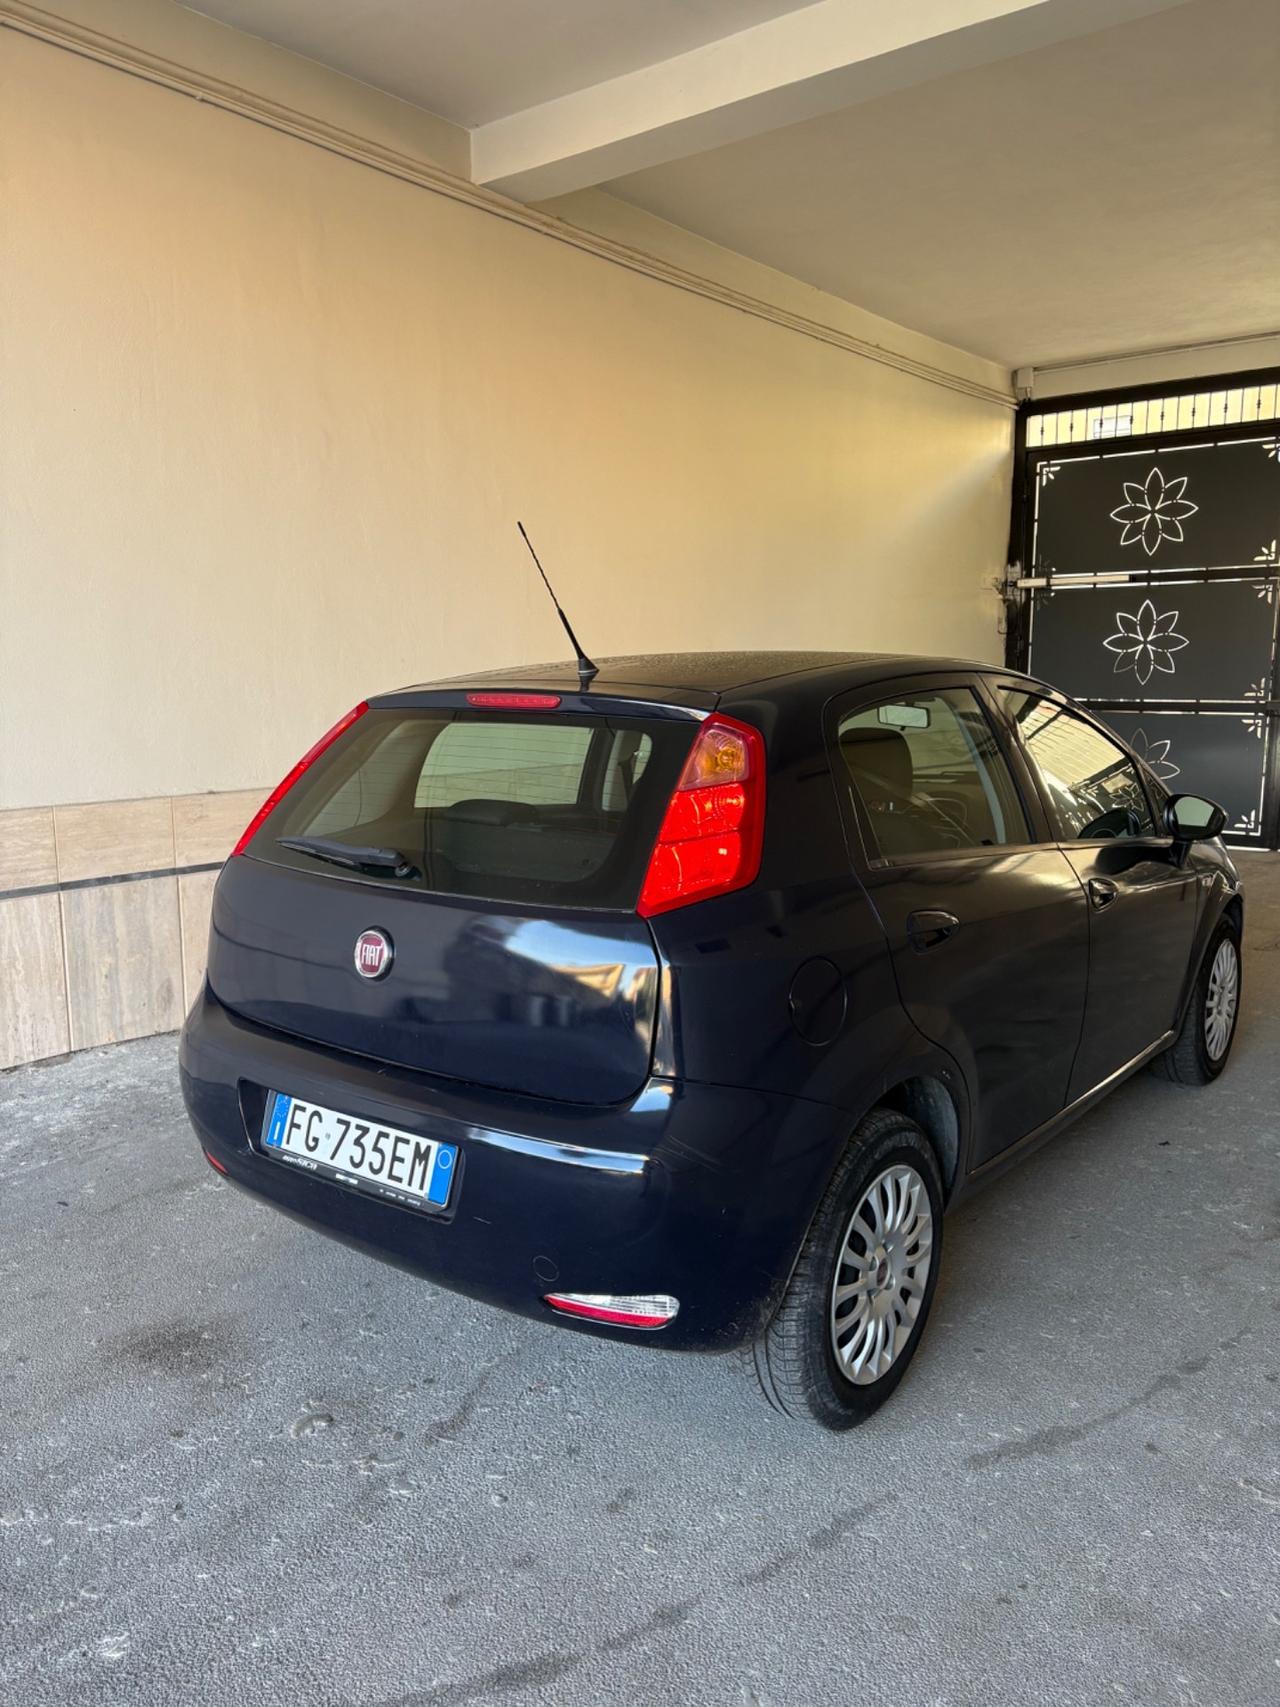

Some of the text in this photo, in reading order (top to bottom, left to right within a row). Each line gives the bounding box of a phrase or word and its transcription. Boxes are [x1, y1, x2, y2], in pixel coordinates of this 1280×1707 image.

[361, 943, 382, 967] FIAT
[284, 1103, 432, 1191] FG 735EM
